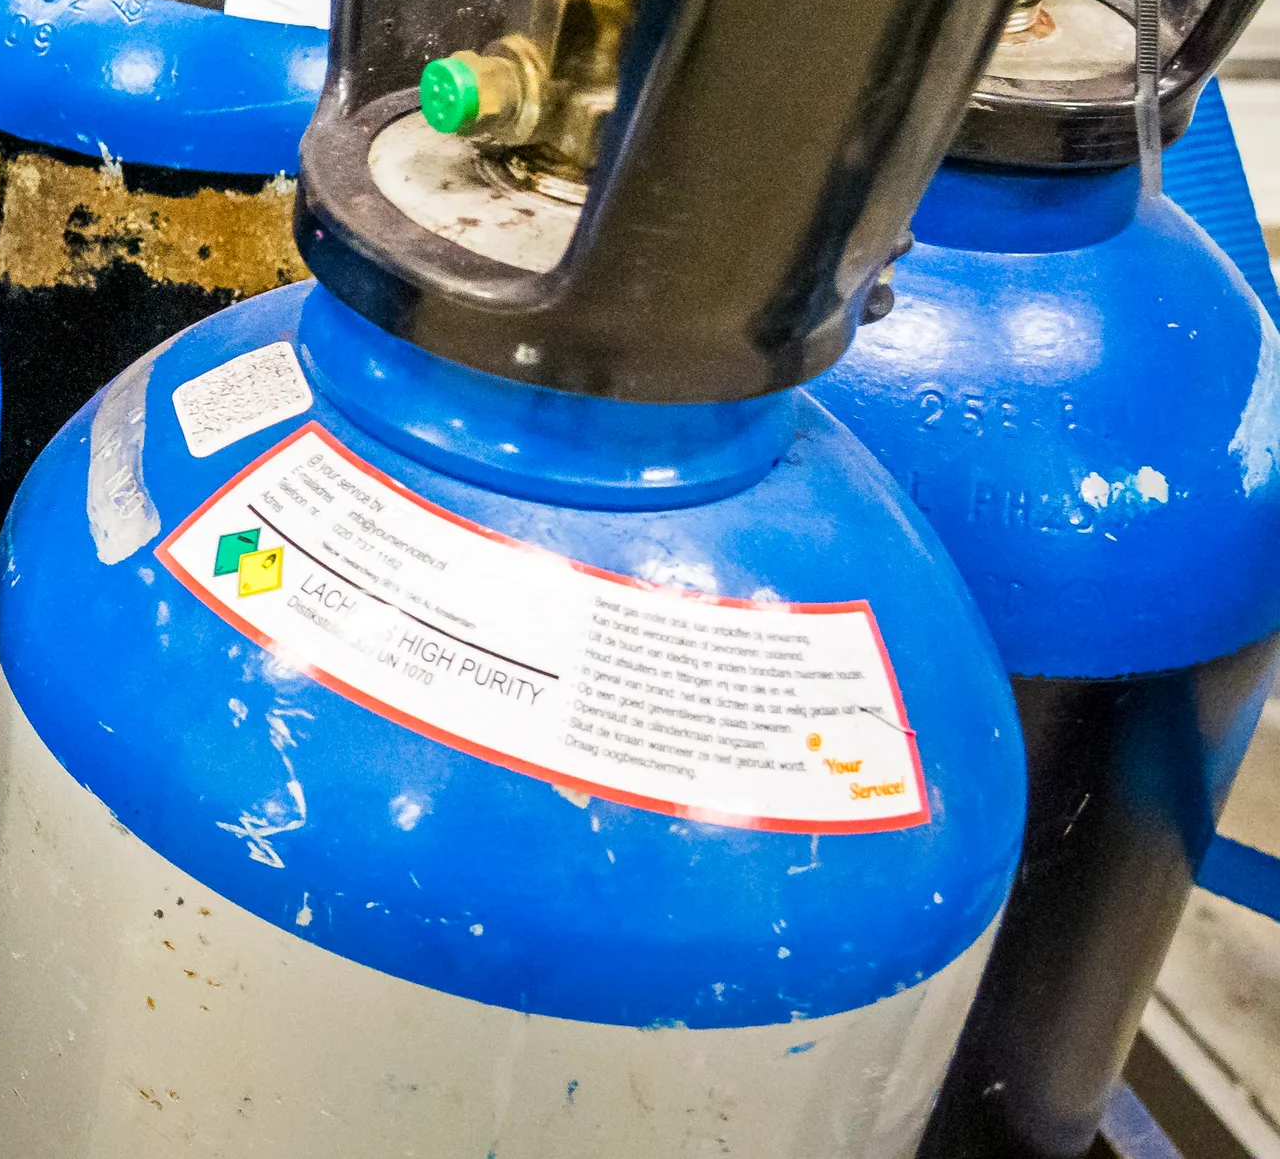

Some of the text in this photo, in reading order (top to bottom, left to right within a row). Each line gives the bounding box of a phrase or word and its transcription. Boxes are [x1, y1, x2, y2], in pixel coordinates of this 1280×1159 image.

[320, 462, 341, 481] your
[337, 477, 370, 504] service
[369, 497, 385, 513] bv
[376, 650, 435, 686] UN 1070
[397, 629, 545, 705] HIGH PURITY
[823, 758, 863, 775] Your
[849, 776, 906, 800] Service!
